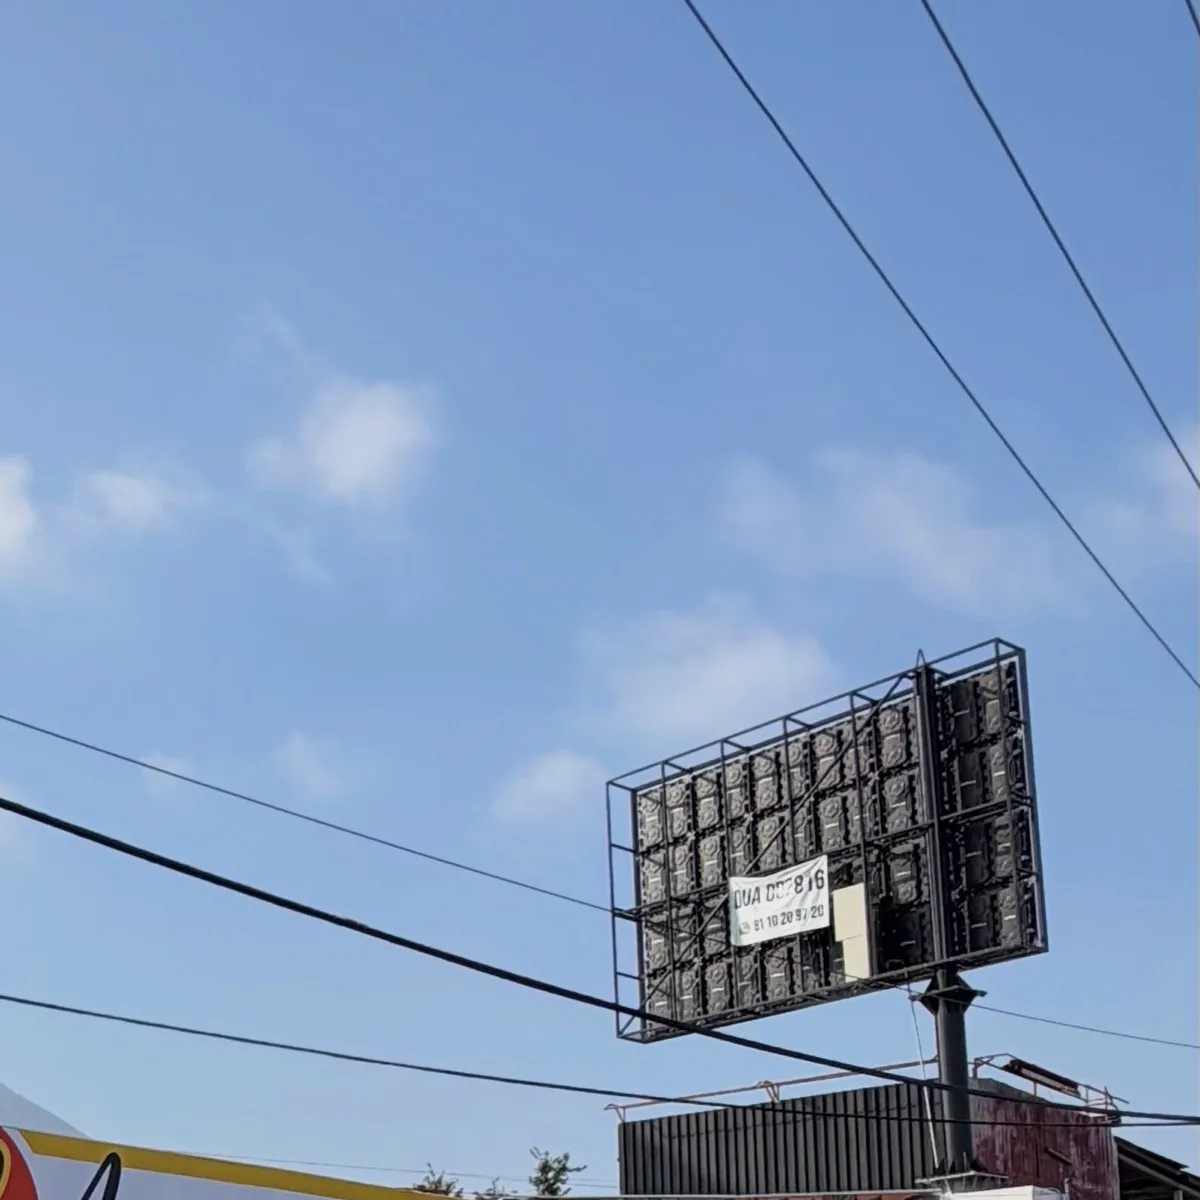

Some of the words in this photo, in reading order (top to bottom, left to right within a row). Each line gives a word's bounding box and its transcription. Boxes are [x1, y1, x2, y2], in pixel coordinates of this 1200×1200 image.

[753, 918, 764, 932] 81
[767, 914, 779, 928] 10
[780, 911, 793, 925] 20
[810, 905, 824, 919] 20
